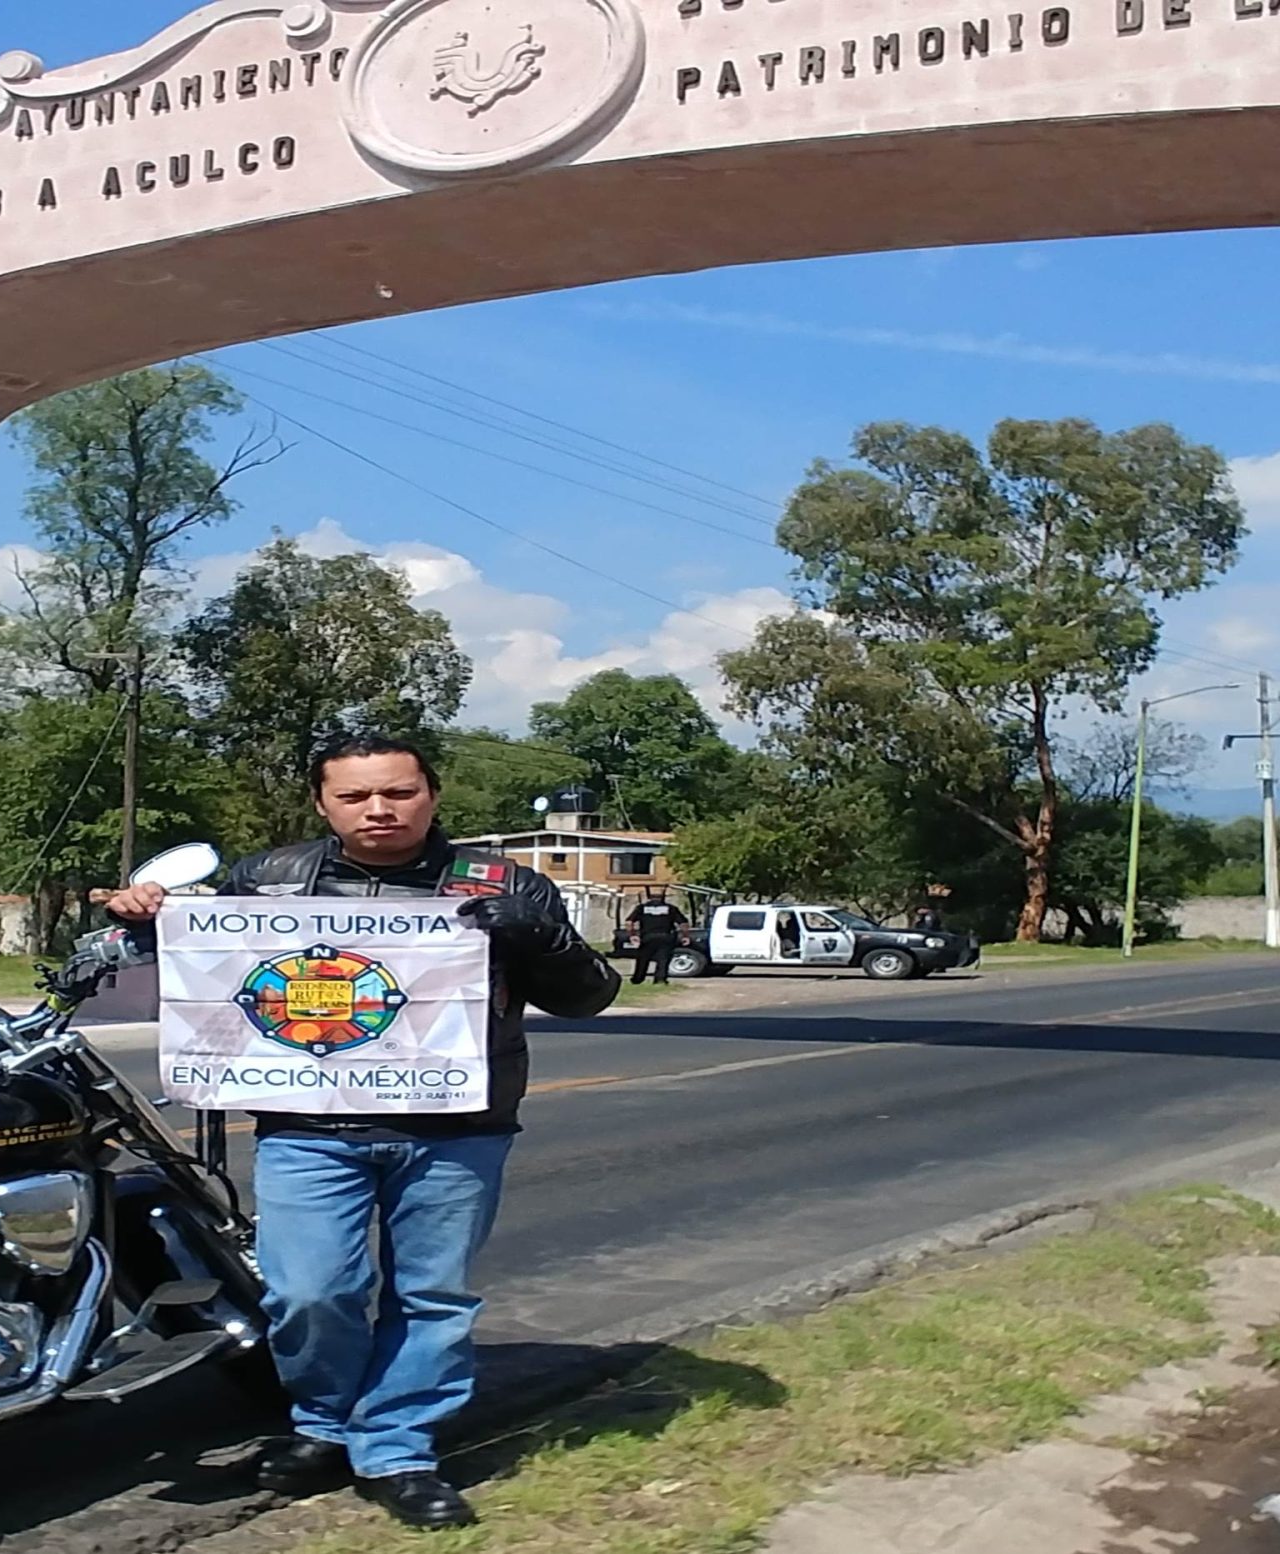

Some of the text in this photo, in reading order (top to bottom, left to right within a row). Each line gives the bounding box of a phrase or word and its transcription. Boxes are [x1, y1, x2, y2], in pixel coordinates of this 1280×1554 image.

[676, 6, 1071, 105] PATRIMONIO
[1115, 0, 1192, 37] DE
[14, 47, 350, 142] AYUNTAMIENTO
[37, 177, 57, 211] A
[101, 135, 296, 200] ACULCO
[189, 912, 451, 935] MOTO TURISTA
[312, 948, 330, 957] N
[172, 1065, 468, 1088] EN ACCIÓN MÉXICO
